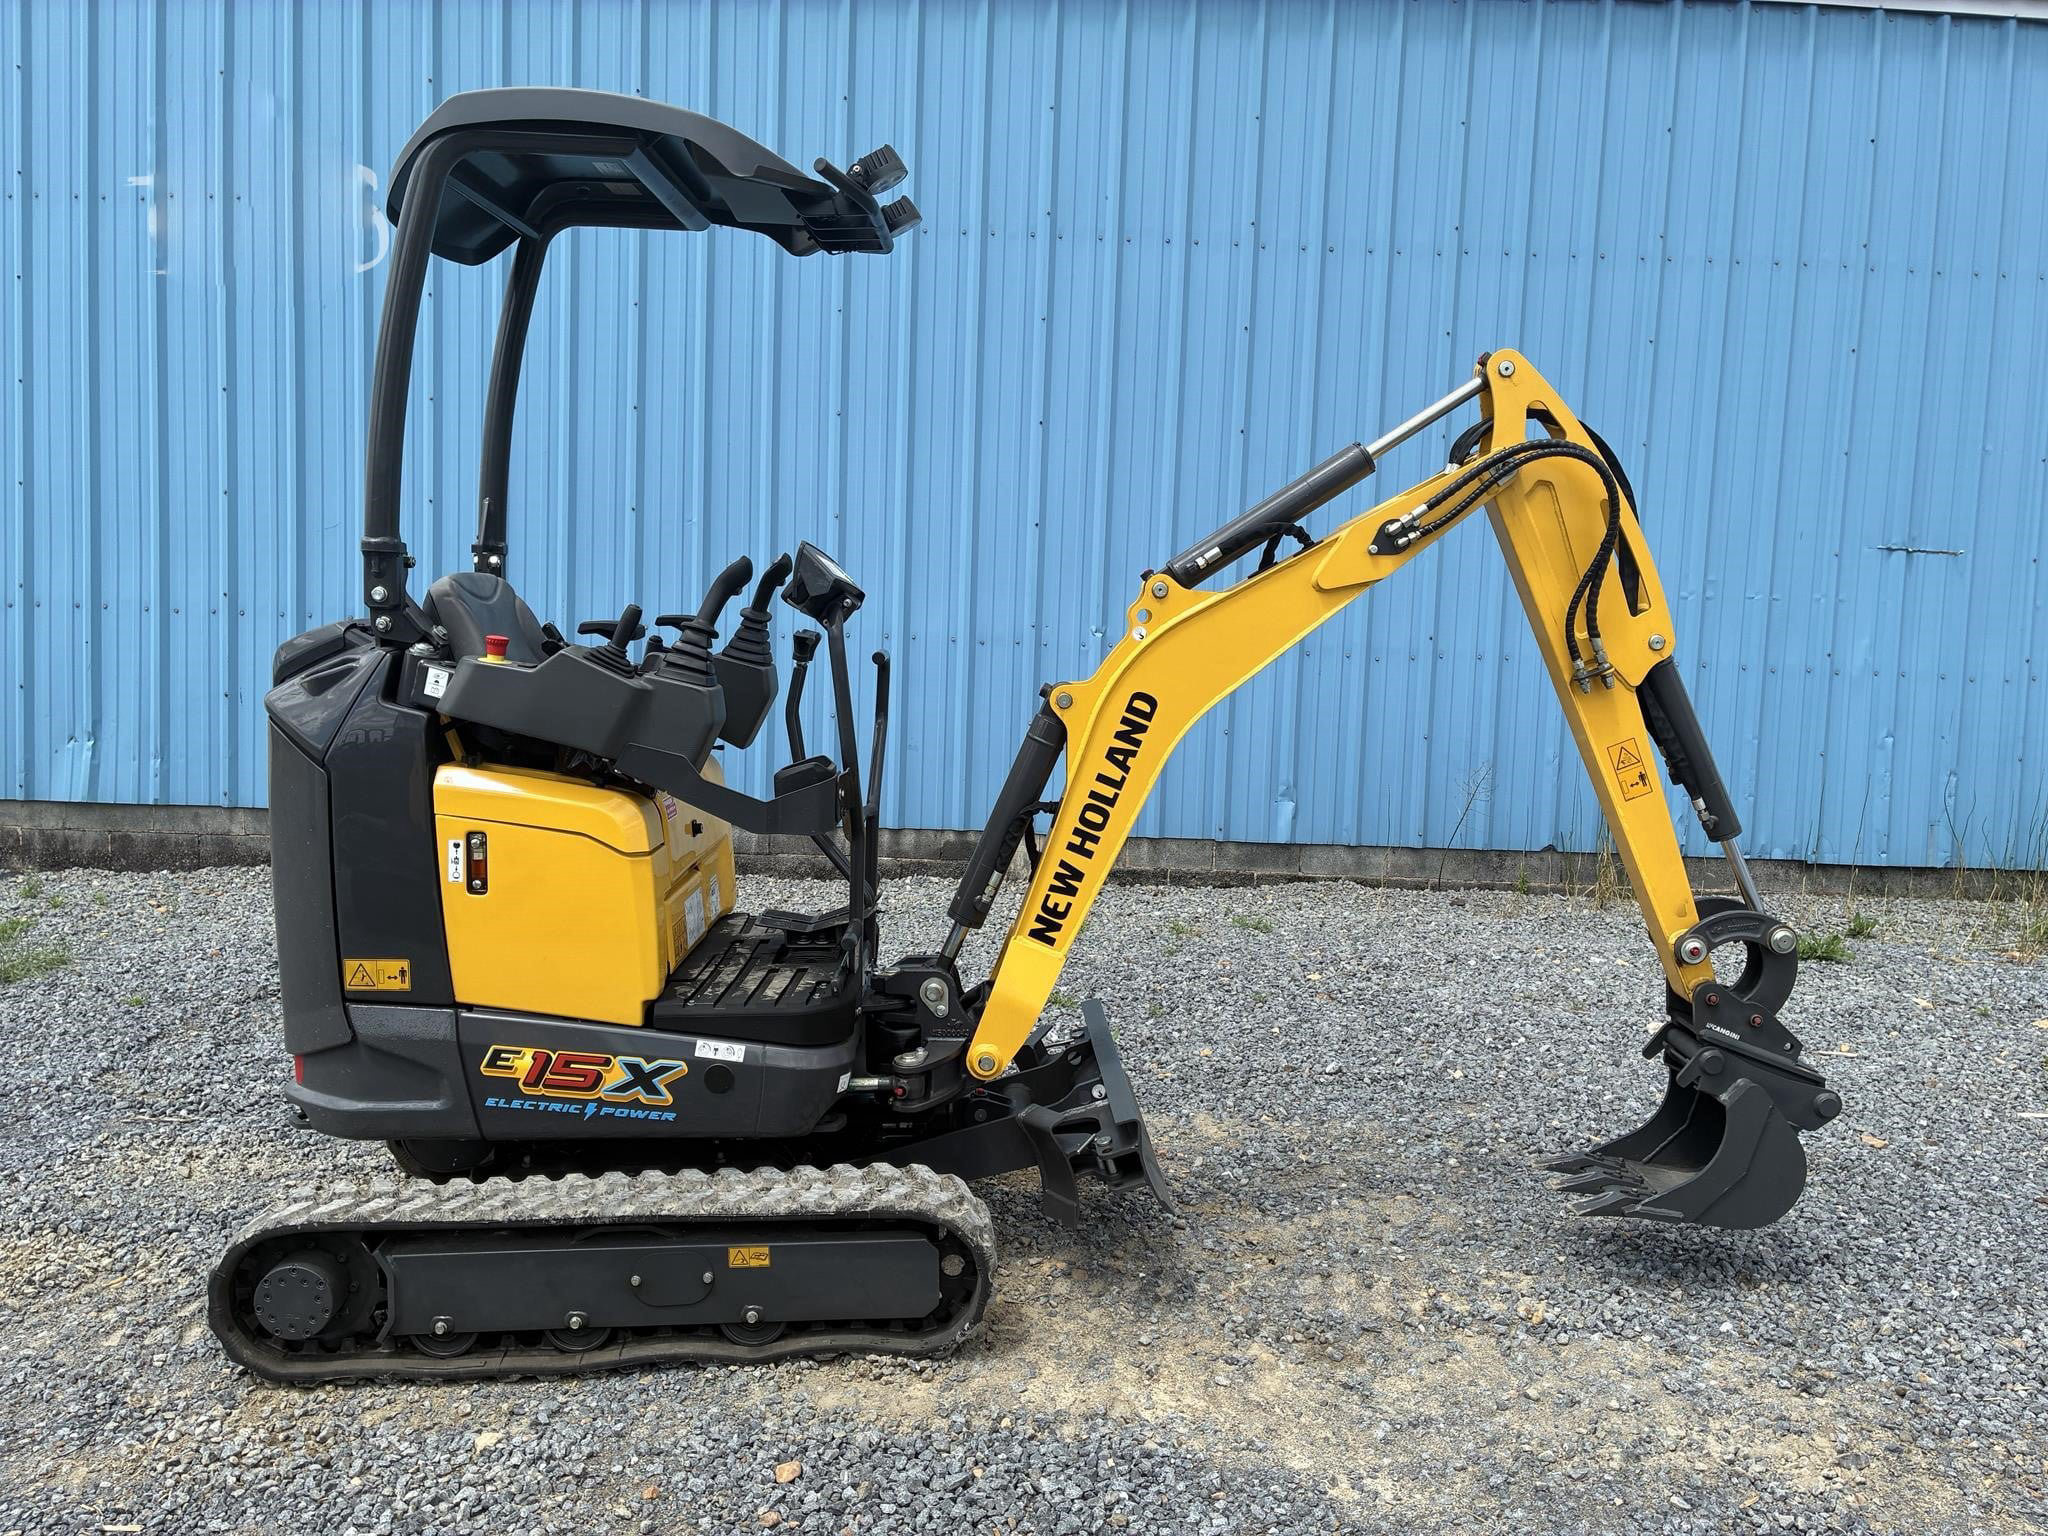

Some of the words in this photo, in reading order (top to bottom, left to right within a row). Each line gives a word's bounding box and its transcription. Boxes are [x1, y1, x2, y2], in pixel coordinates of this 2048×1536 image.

[1028, 858, 1085, 947] NEW
[1065, 691, 1158, 859] HOLLAND
[485, 1098, 580, 1113] ELECTRIC
[600, 1107, 677, 1121] POWER
